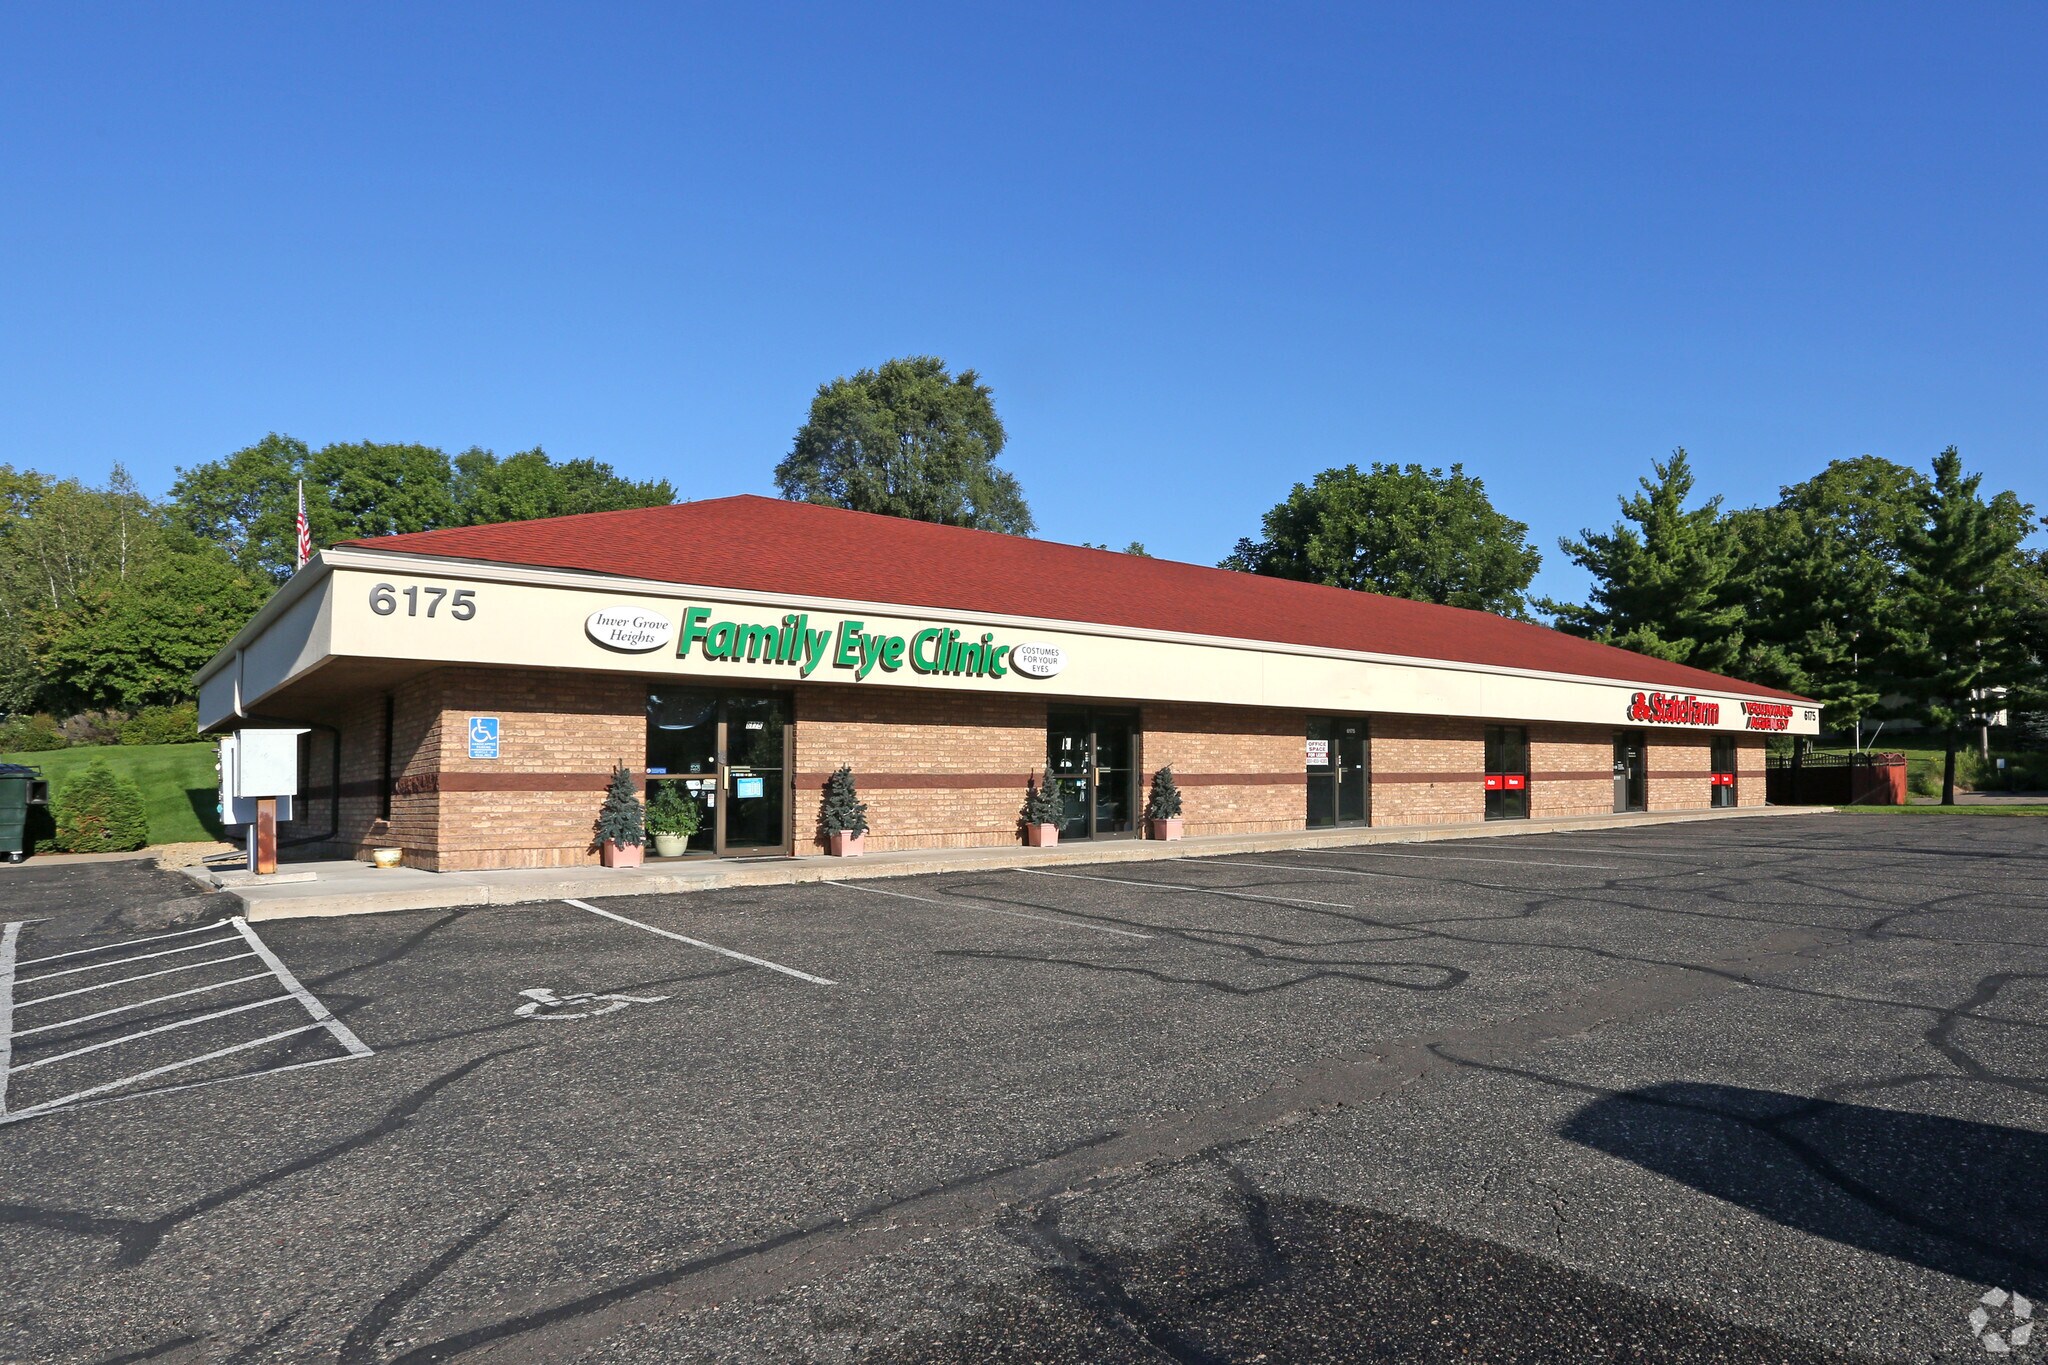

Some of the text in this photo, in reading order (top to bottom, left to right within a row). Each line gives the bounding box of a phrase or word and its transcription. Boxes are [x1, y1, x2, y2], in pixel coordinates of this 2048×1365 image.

[369, 583, 476, 621] 6175
[596, 613, 669, 630] Inver Grove
[610, 629, 655, 646] Heights
[677, 606, 1010, 682] Family Eye Clinic
[1021, 646, 1060, 656] COSTUMES
[1023, 655, 1058, 665] FOR YOUR
[1032, 664, 1049, 673] EYES
[1804, 710, 1817, 721] 6175
